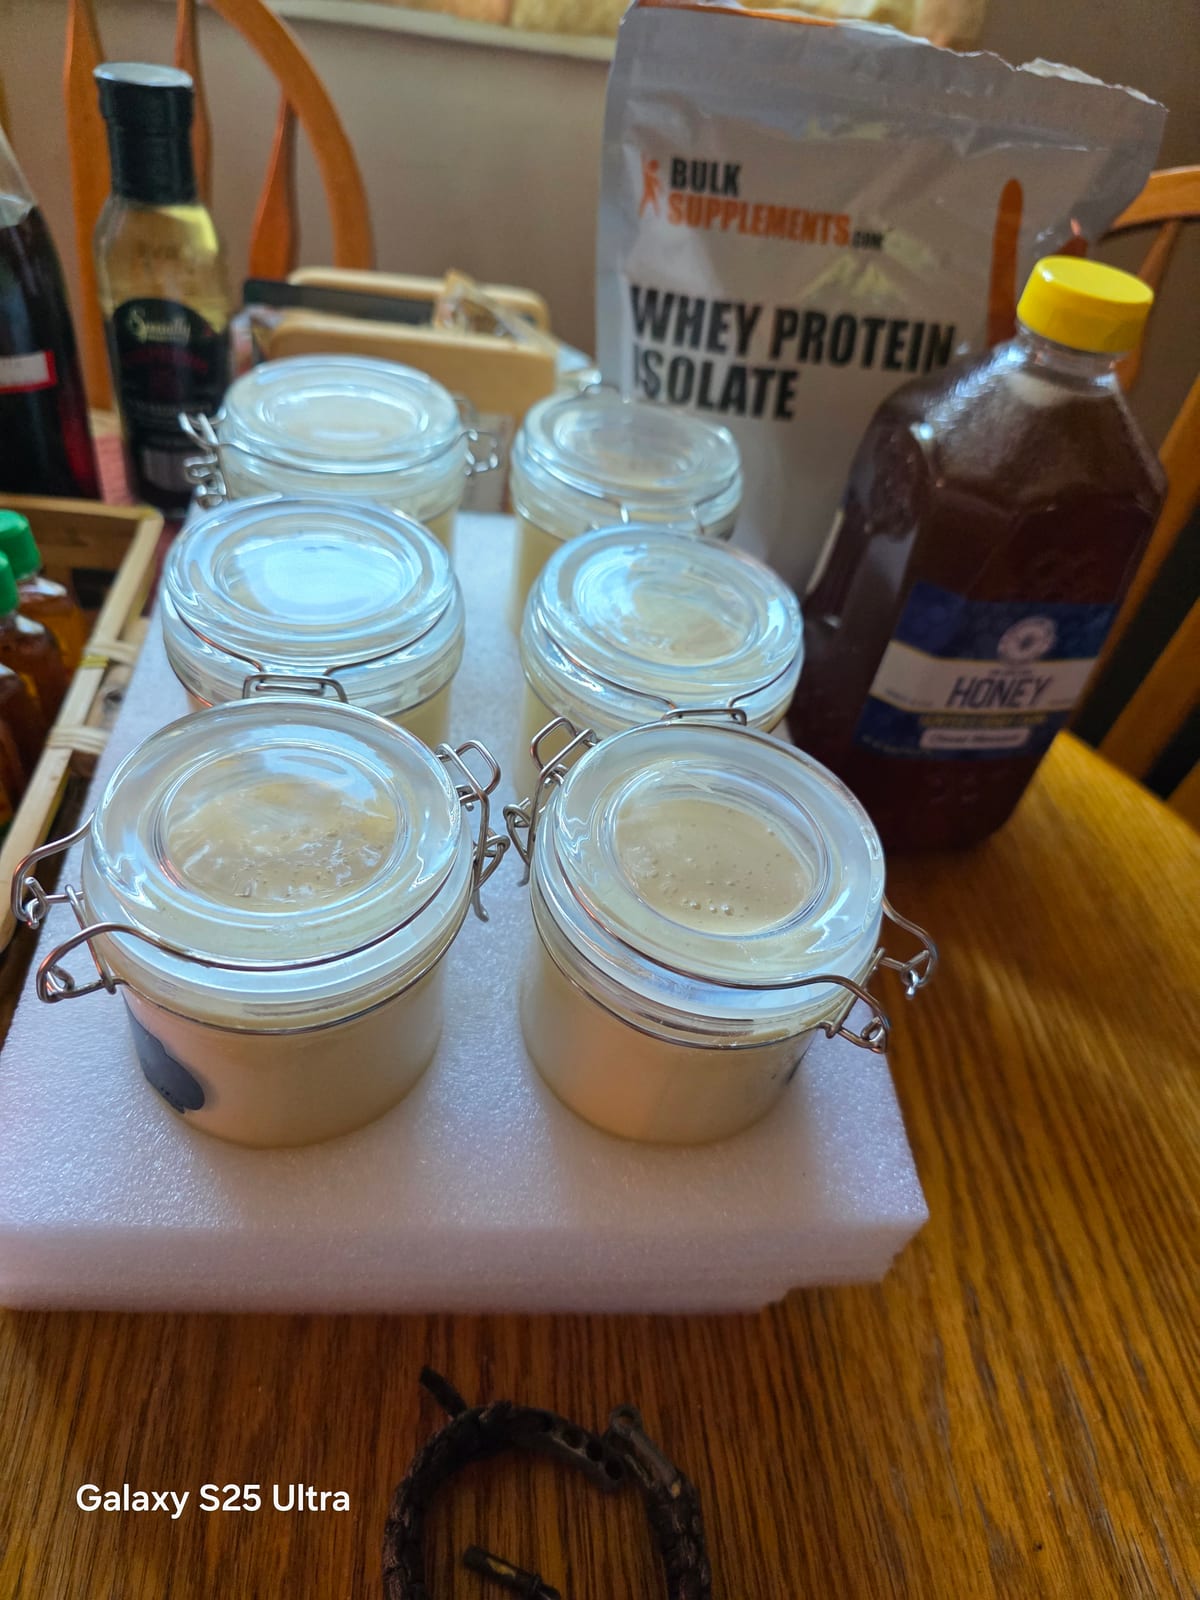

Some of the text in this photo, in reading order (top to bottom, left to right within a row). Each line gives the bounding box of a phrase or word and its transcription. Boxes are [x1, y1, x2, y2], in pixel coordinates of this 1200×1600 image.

[670, 158, 742, 196] BULK
[631, 286, 957, 374] WHEY PROTEIN
[634, 346, 800, 421] ISOLATE
[946, 677, 1053, 709] HONEY
